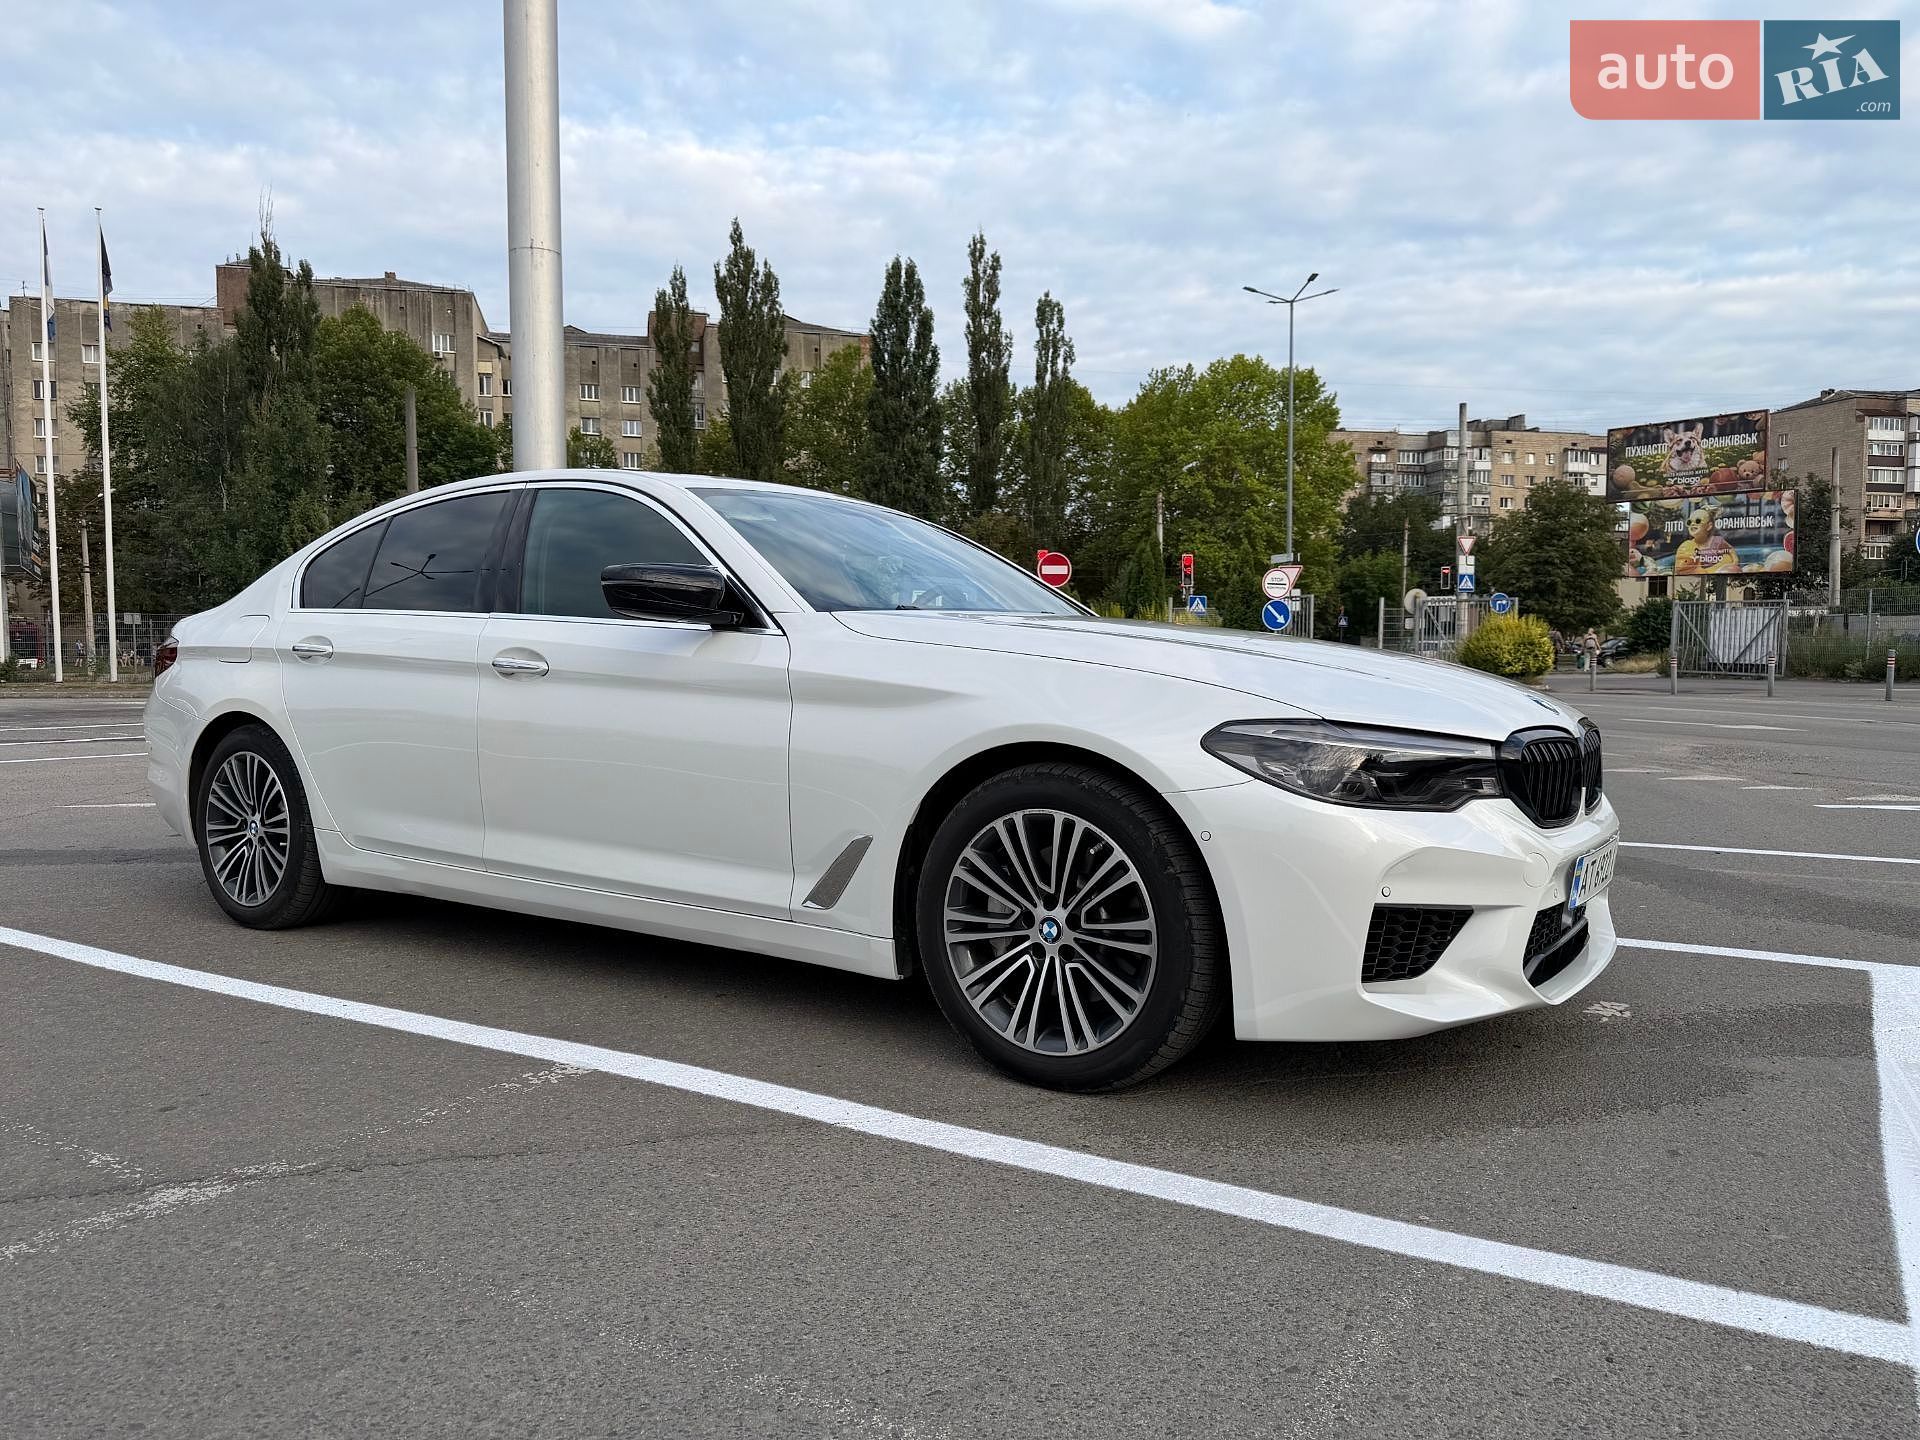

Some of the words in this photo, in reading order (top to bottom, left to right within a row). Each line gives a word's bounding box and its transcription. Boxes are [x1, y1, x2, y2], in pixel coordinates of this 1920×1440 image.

[1625, 442, 1668, 458] ПУХНАСТО
[1700, 432, 1758, 449] ФРАНКІВСЬК
[1664, 521, 1684, 533] ЛІТО
[1714, 515, 1773, 530] ФРАНКІВСЬК
